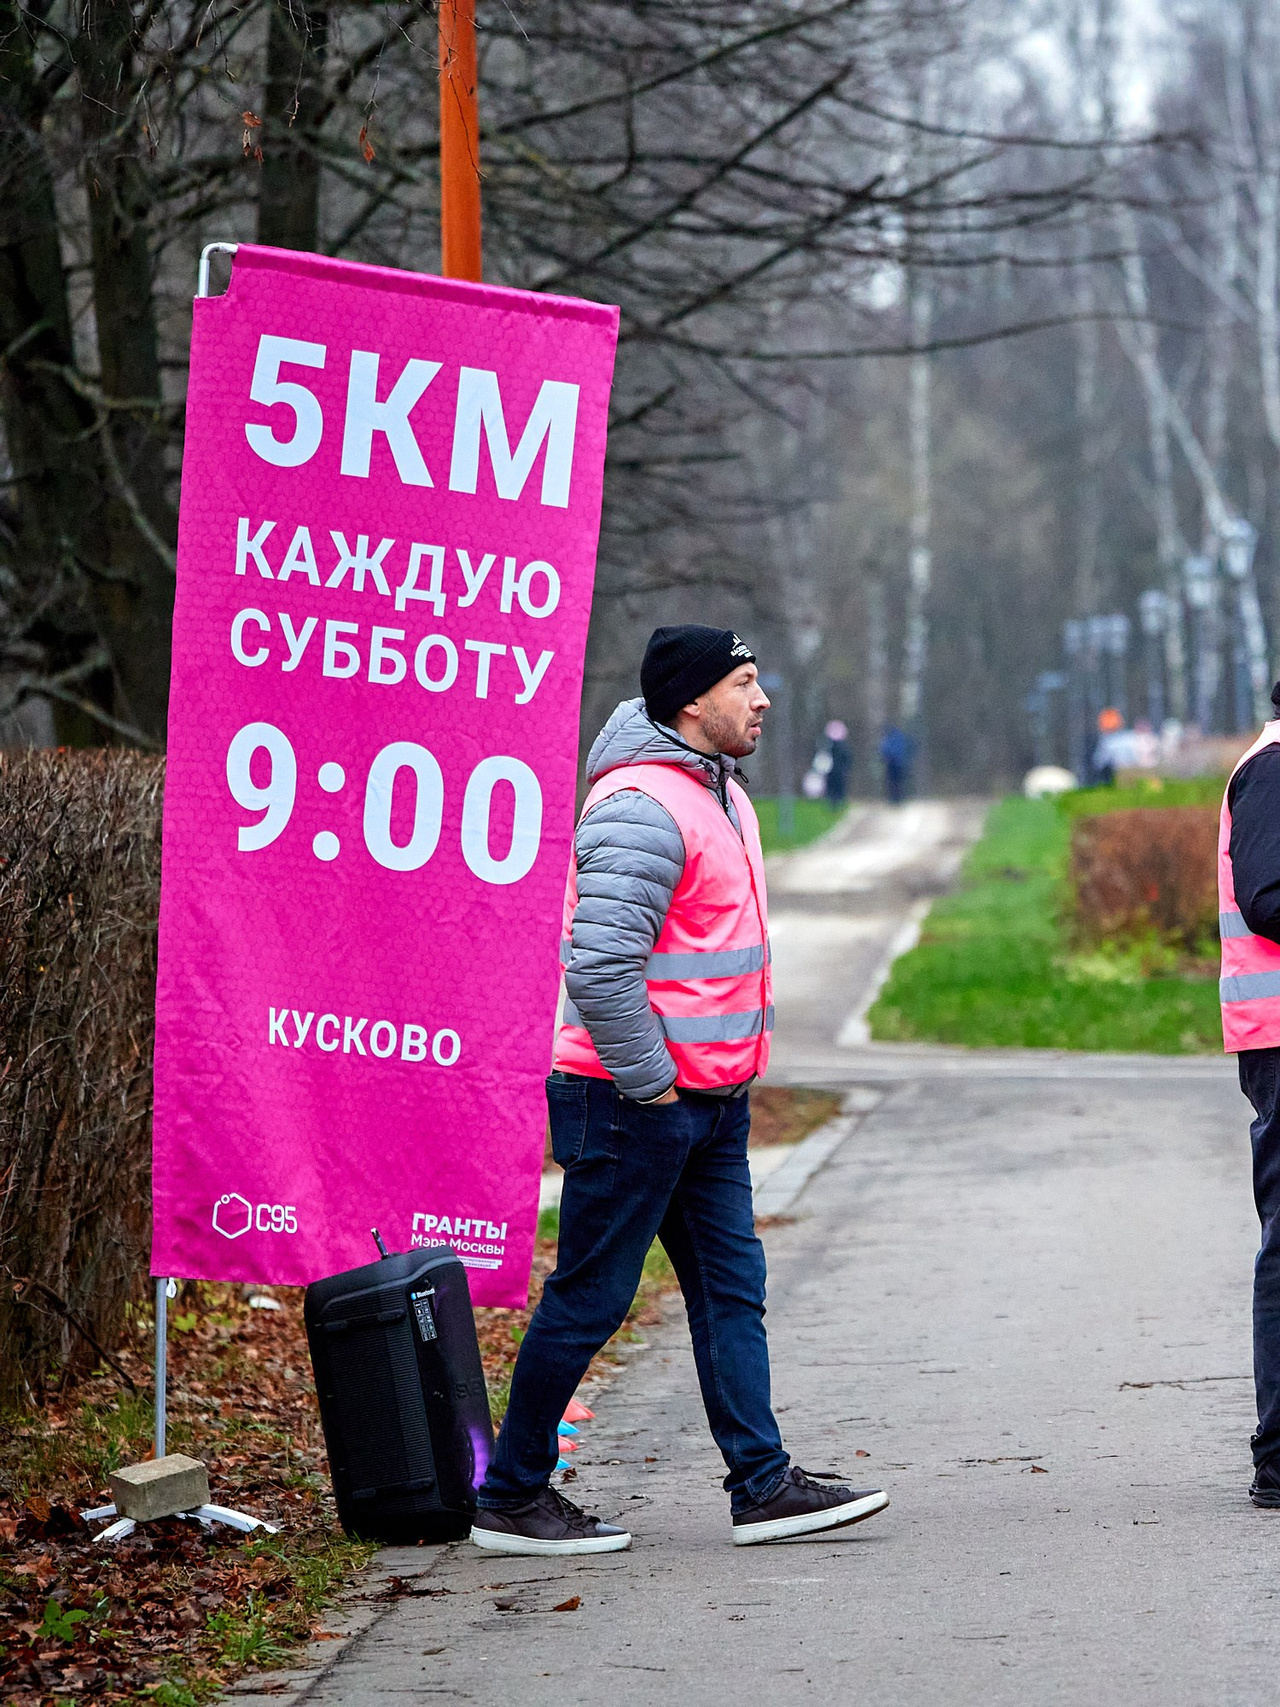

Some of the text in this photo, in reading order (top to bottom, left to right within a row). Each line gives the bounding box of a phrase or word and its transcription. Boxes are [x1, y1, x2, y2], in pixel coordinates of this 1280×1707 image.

[245, 334, 580, 508] 5КМ
[235, 517, 560, 618] КАЖДУЮ
[231, 608, 554, 704] СУББОТУ
[227, 722, 542, 884] 9:00
[269, 1007, 461, 1066] КУСКОВО
[412, 1213, 508, 1240] ГРАНТЫ
[450, 1238, 505, 1255] Москвы
